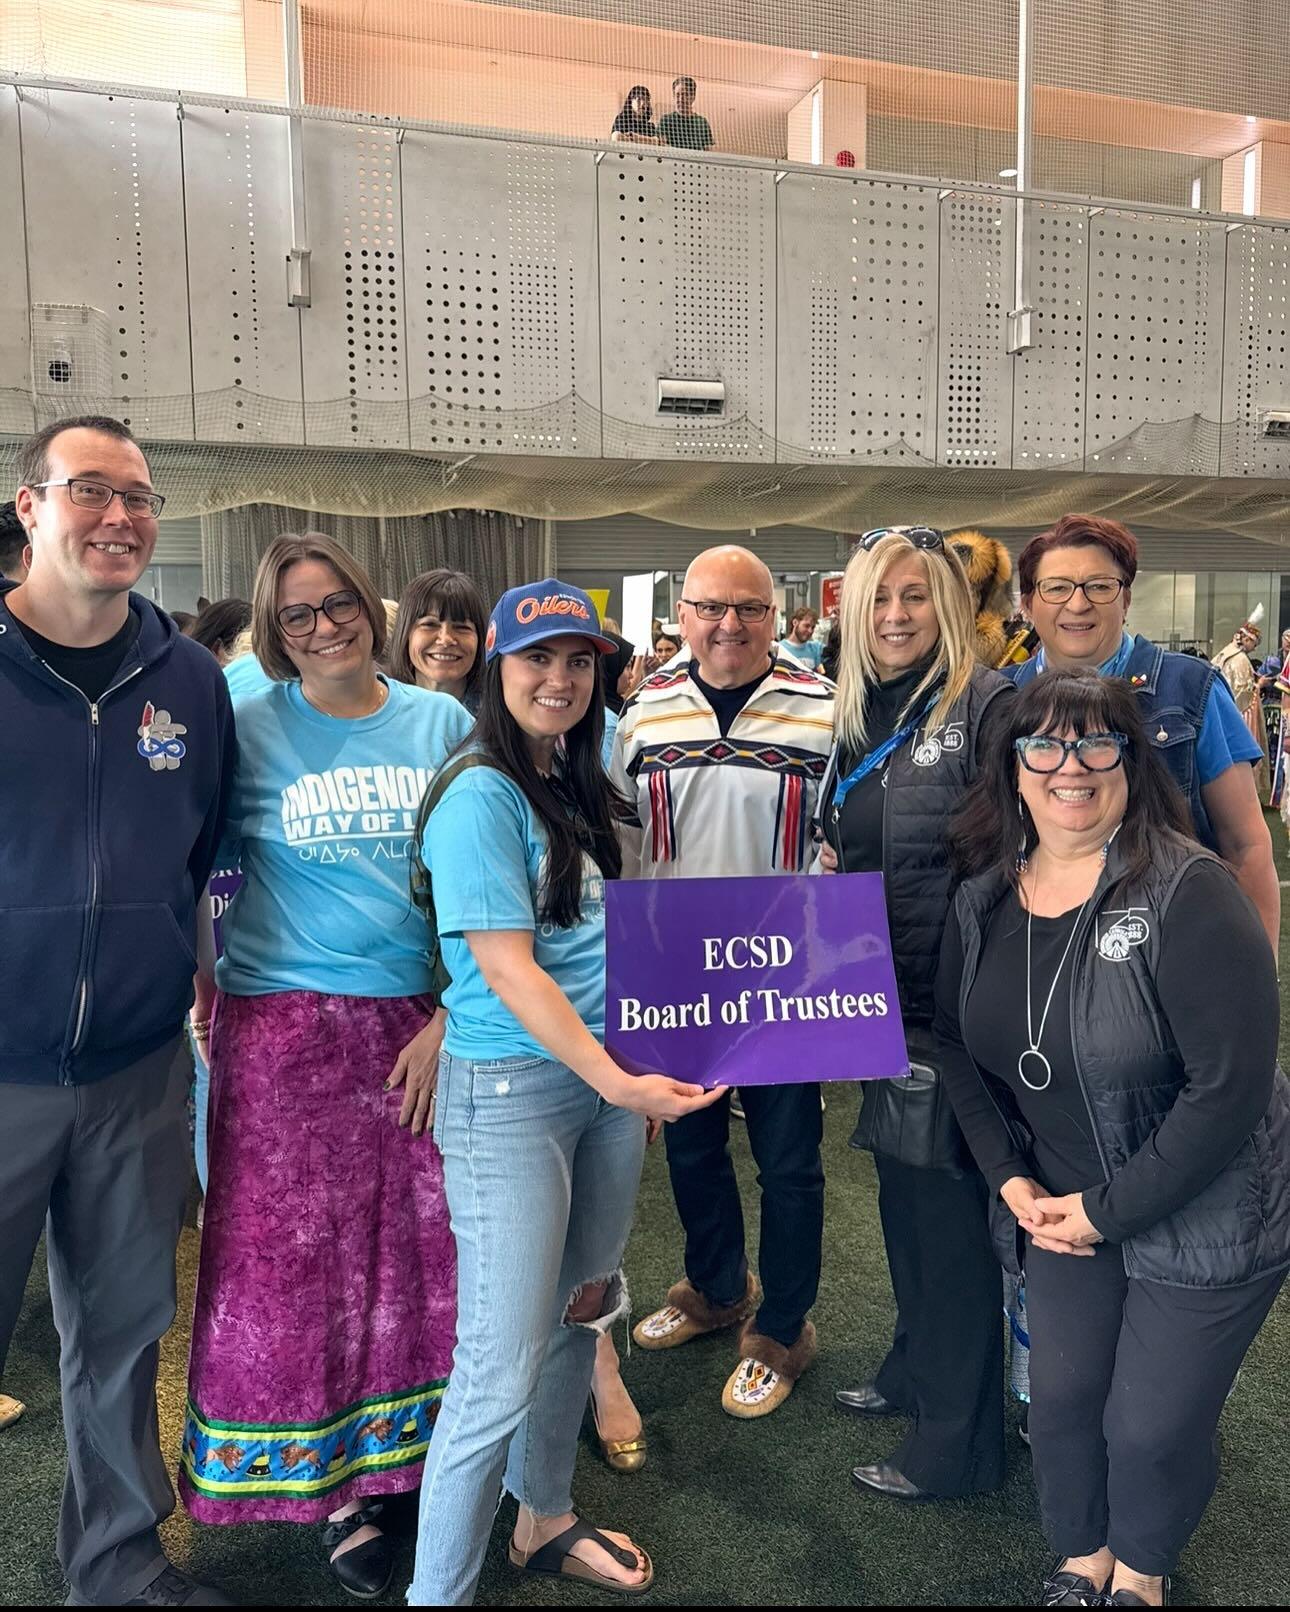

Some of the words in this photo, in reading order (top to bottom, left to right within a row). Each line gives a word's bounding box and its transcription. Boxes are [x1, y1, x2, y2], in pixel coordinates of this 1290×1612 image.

[515, 595, 590, 624] Oilers
[281, 766, 434, 821] INDIGENOU
[284, 814, 353, 841] WAY
[361, 812, 397, 832] OF
[702, 935, 793, 971] ECSD
[618, 993, 712, 1032] Board
[720, 990, 752, 1025] of
[757, 988, 889, 1023] Trustees
